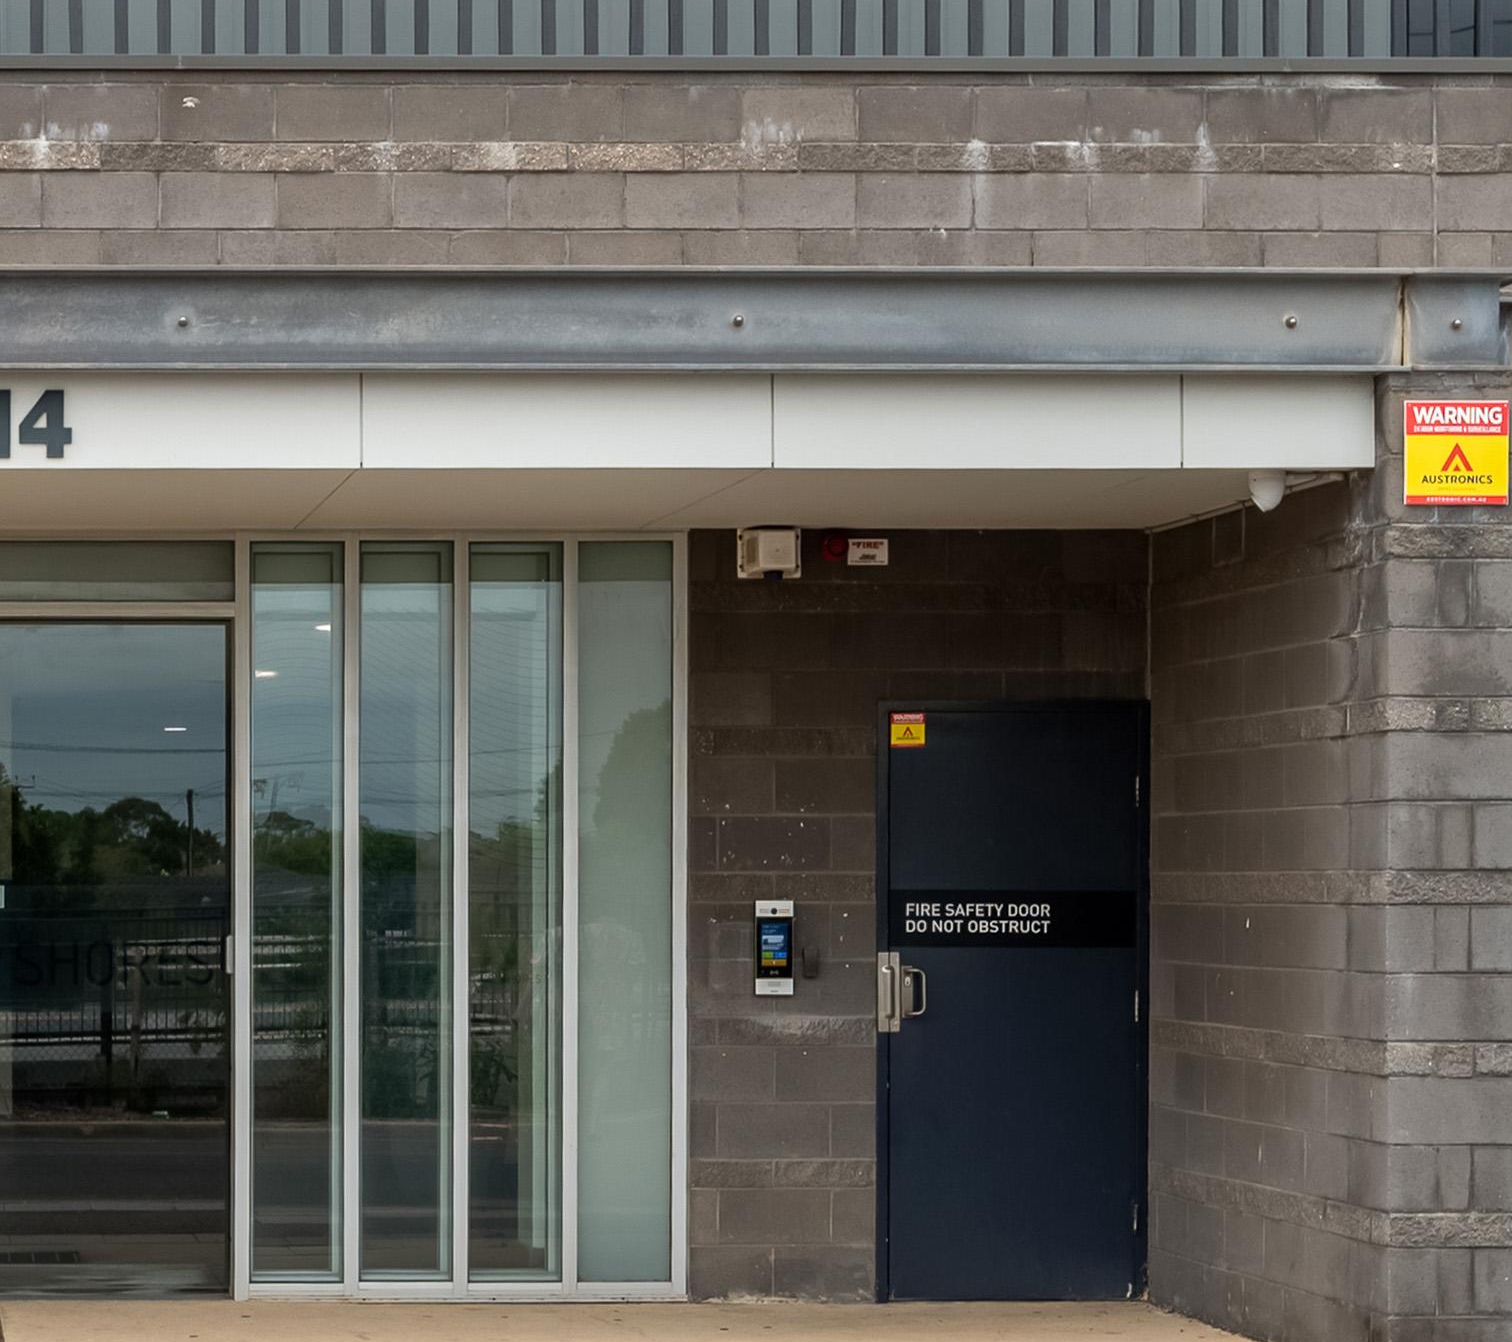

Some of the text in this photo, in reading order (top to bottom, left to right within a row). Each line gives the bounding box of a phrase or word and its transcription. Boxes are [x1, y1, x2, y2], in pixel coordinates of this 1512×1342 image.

[1413, 406, 1503, 424] WARNING
[1421, 475, 1493, 484] AUSTRONICS
[905, 903, 1051, 917] FIRE SAFETY DOOR
[905, 920, 1051, 933] DO NOT OBSTRUCT
[15, 940, 213, 987] SHORES
